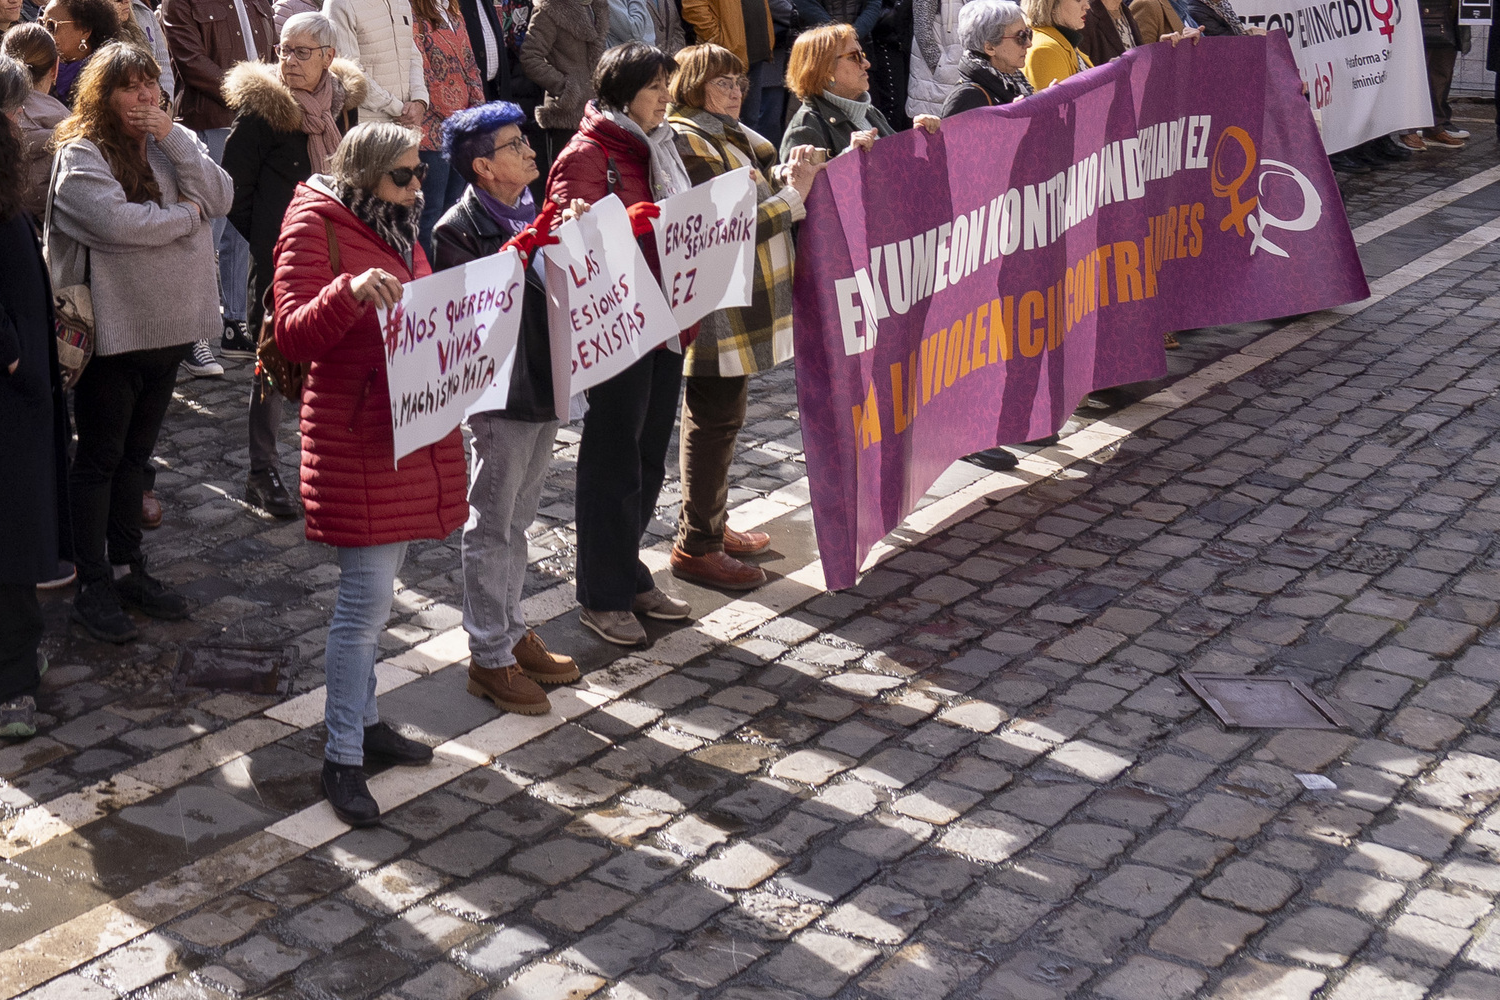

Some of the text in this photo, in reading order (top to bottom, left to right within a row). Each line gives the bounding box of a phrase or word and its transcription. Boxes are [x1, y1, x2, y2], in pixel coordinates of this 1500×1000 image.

[665, 214, 703, 256] ERASO
[983, 152, 1098, 265] KONTRAKO
[1186, 114, 1212, 170] EZ
[568, 249, 600, 289] LAS
[920, 290, 1064, 406] VIOLENCIA
[1065, 240, 1158, 333] CONTRA
